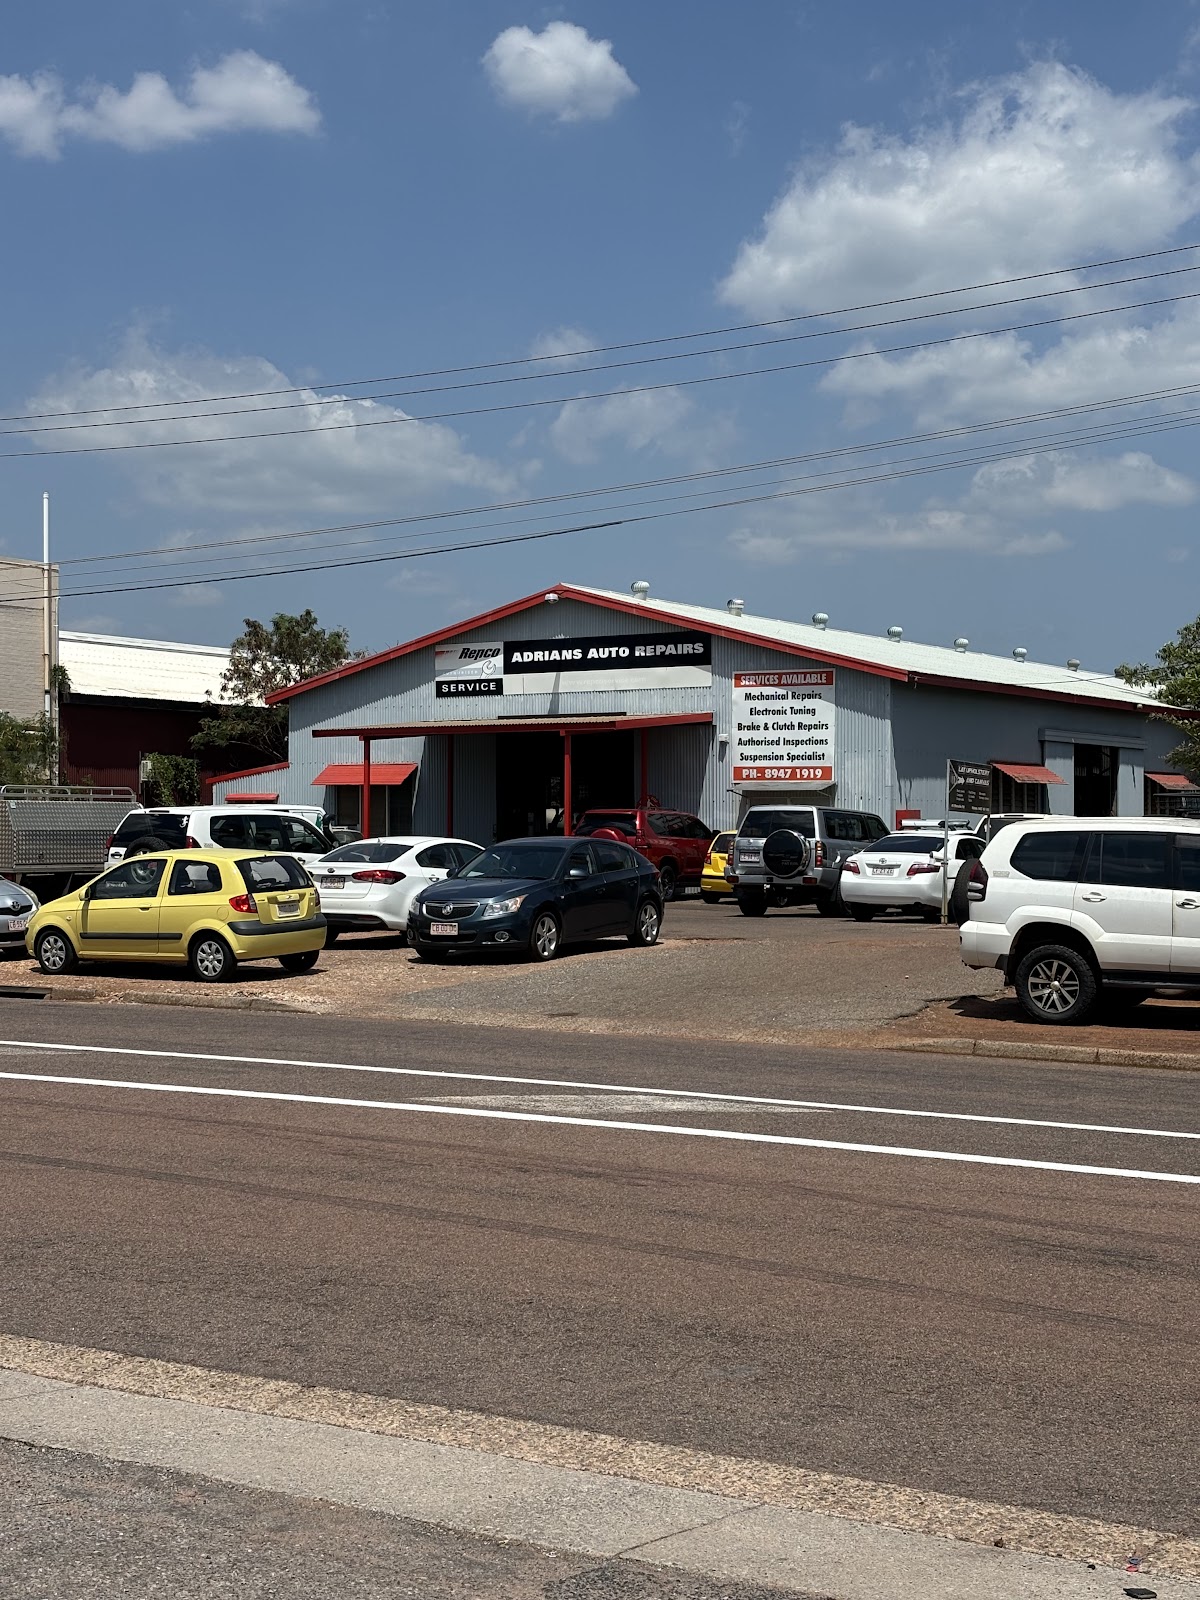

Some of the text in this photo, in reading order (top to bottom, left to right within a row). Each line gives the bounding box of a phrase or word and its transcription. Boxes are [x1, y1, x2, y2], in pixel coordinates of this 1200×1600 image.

[458, 647, 501, 660] Repco
[511, 642, 704, 663] ADRIANS AUTO REPAIRS
[740, 674, 826, 685] SERVICES AVAILABLE
[441, 682, 497, 693] SERVICE
[744, 690, 822, 701] Mechanical Repairs
[749, 705, 816, 716] Electronic Tuning
[738, 721, 828, 732] Brake & Clutch Repairs
[737, 736, 829, 747] Authorised Inspections
[739, 751, 826, 762] Suspension Specialist
[742, 769, 823, 778] PH- 8947 1919
